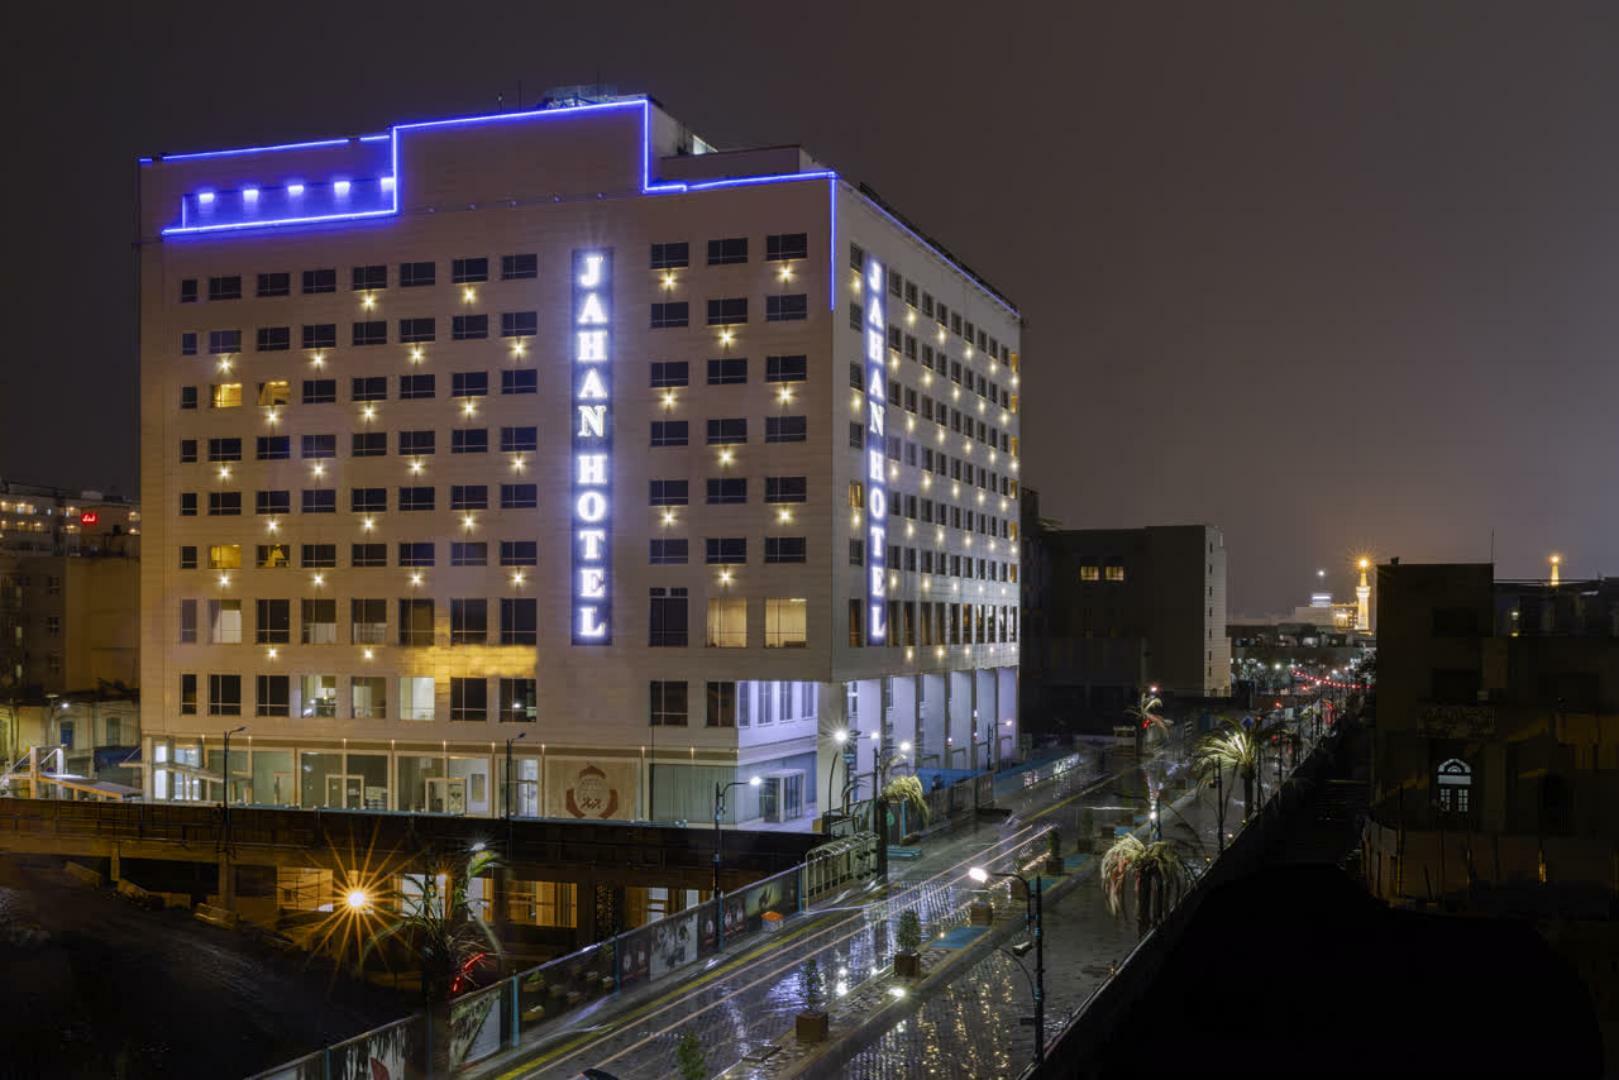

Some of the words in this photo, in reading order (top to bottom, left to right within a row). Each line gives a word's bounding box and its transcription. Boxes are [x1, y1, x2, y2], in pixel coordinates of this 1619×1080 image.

[577, 255, 608, 438] JAHAN
[868, 260, 886, 438] JAHAN
[577, 454, 607, 638] HOTEL
[869, 449, 886, 638] HOTEL
